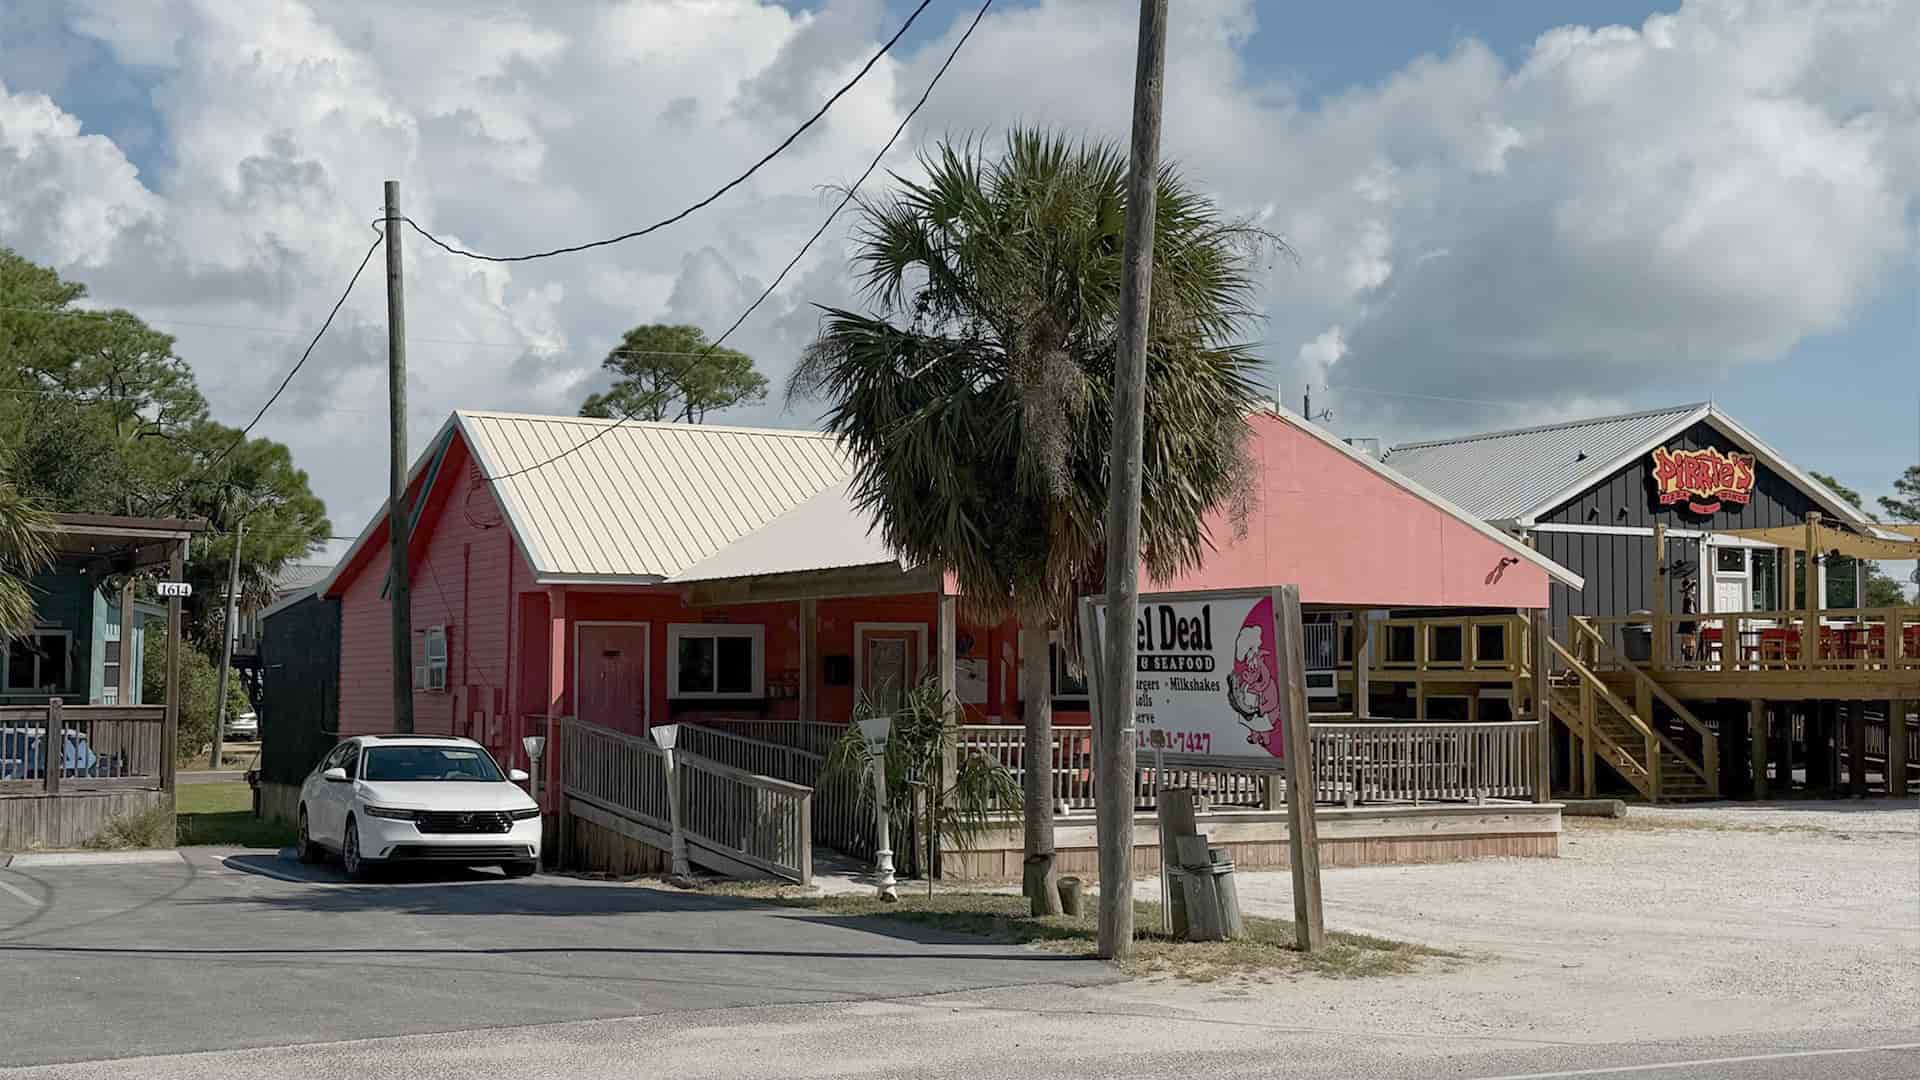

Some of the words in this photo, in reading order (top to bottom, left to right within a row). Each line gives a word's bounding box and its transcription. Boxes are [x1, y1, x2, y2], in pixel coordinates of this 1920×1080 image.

[162, 583, 189, 596] 1614
[1137, 605, 1154, 651] el
[1158, 604, 1213, 651] Deal
[1154, 657, 1213, 670] SEAFOOD
[1136, 678, 1160, 692] urgers
[1169, 676, 1220, 692] Milkshakes
[1136, 711, 1155, 724] erve
